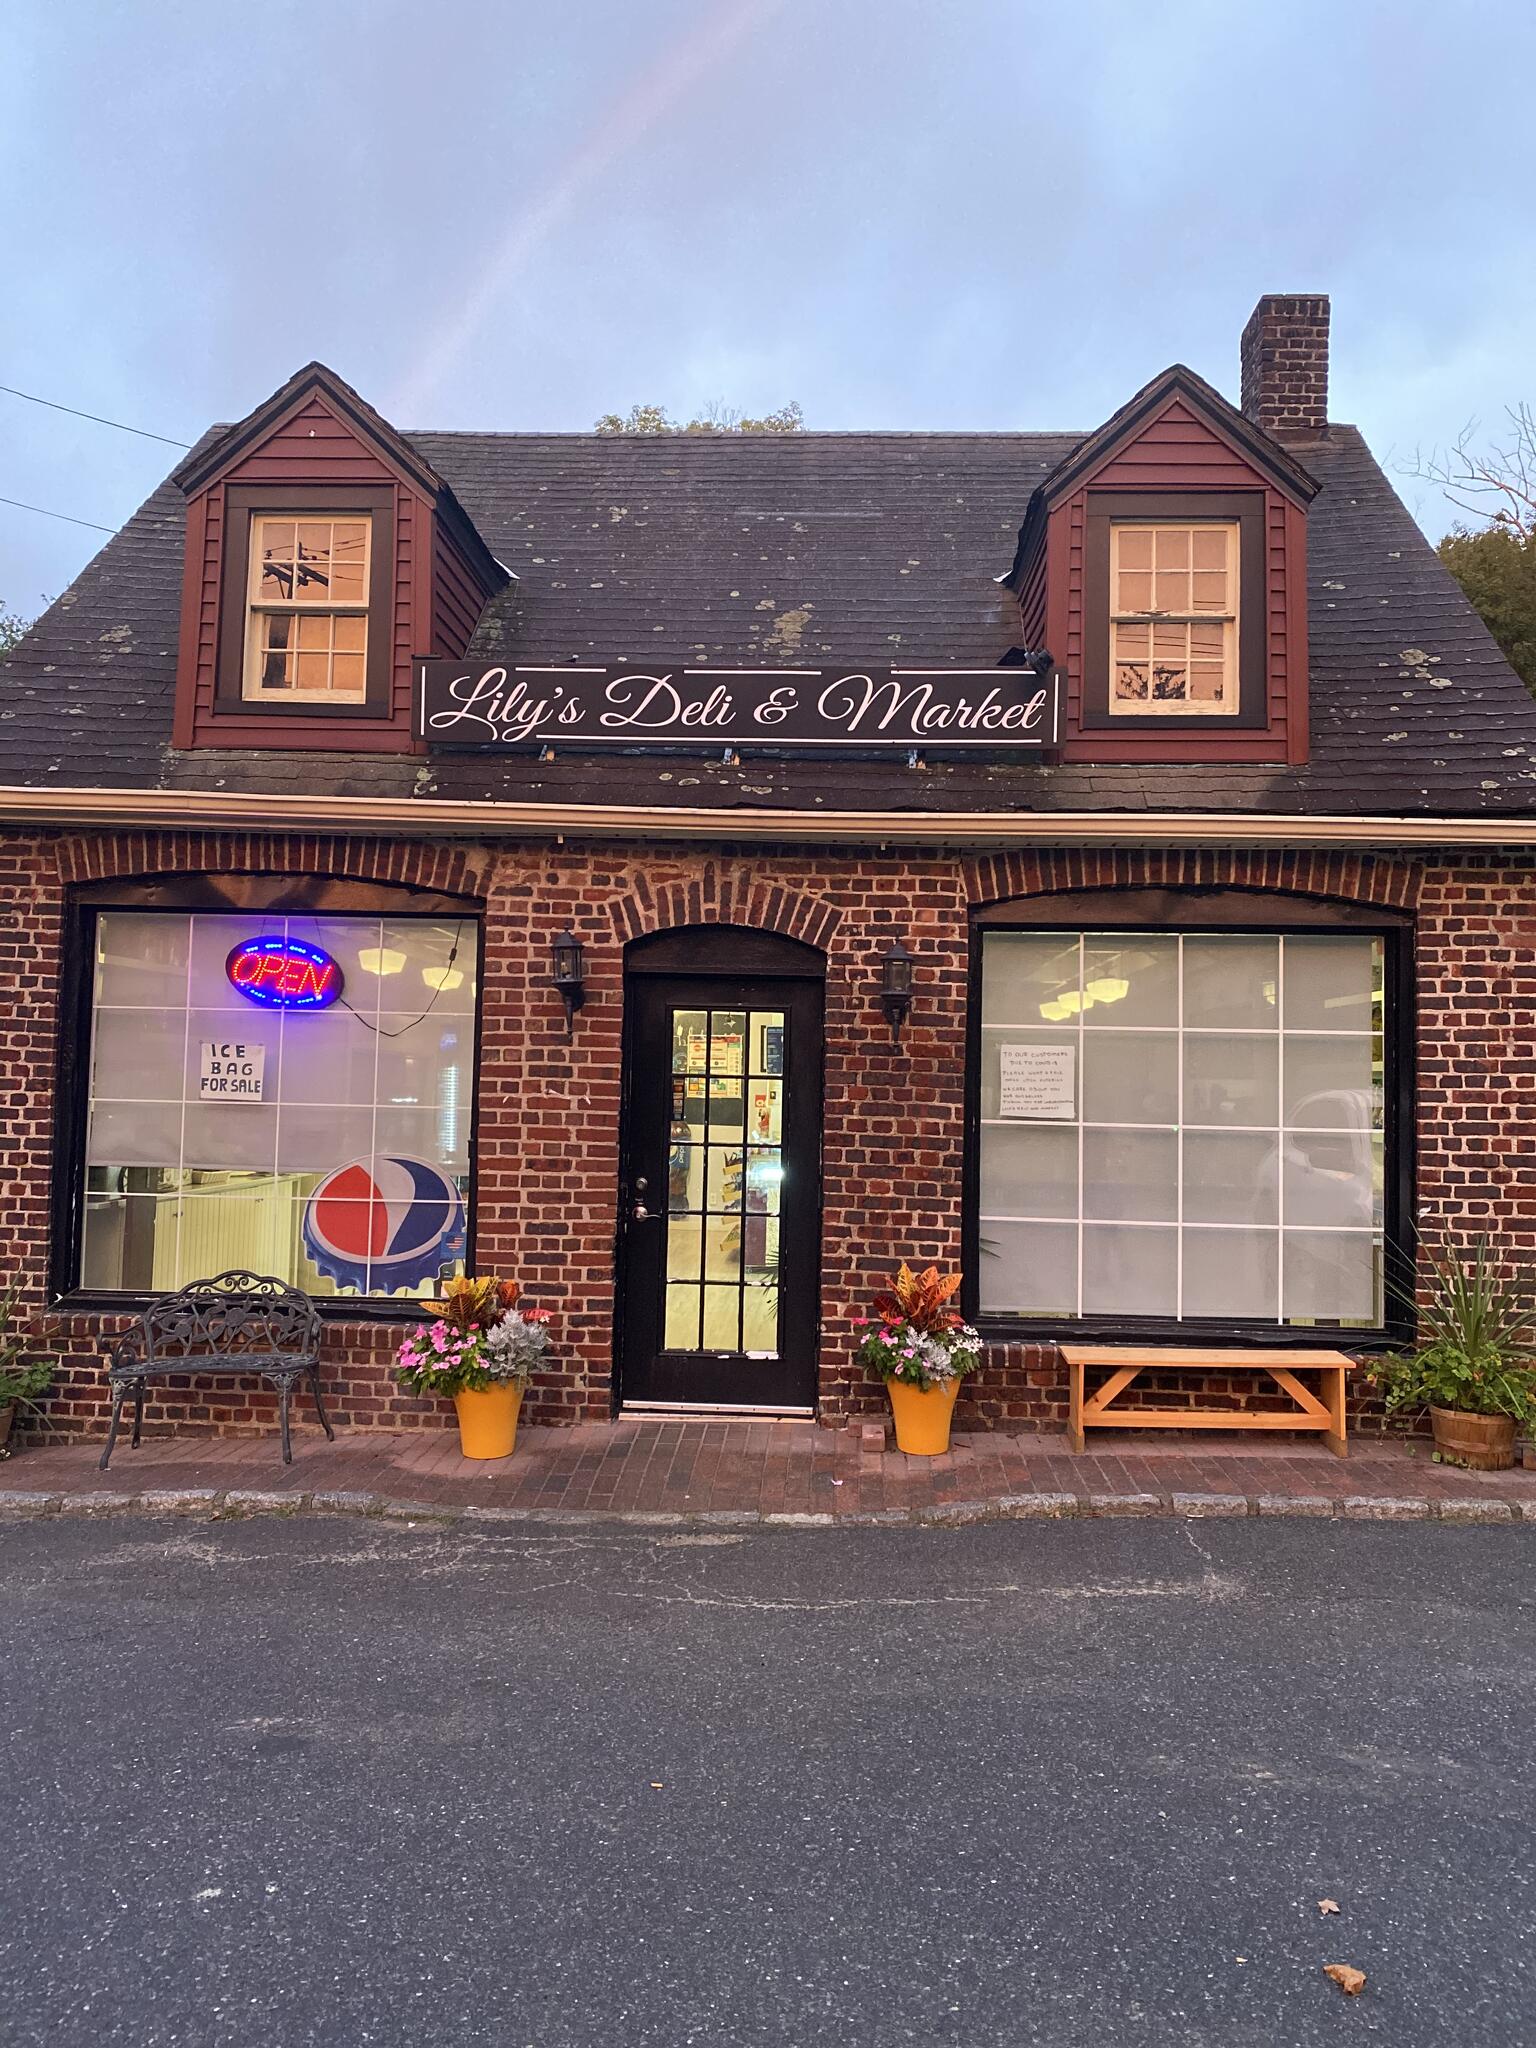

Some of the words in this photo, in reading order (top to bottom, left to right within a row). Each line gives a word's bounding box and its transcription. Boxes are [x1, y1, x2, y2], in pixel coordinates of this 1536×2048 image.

[429, 668, 585, 742] Lily's
[599, 669, 736, 729] Deli
[753, 687, 799, 724] &
[817, 674, 1045, 735] Market
[232, 952, 332, 995] OPEN
[211, 1044, 245, 1058] ICE
[211, 1062, 252, 1075] BAG
[201, 1078, 227, 1091] FOR
[230, 1079, 261, 1093] SALE
